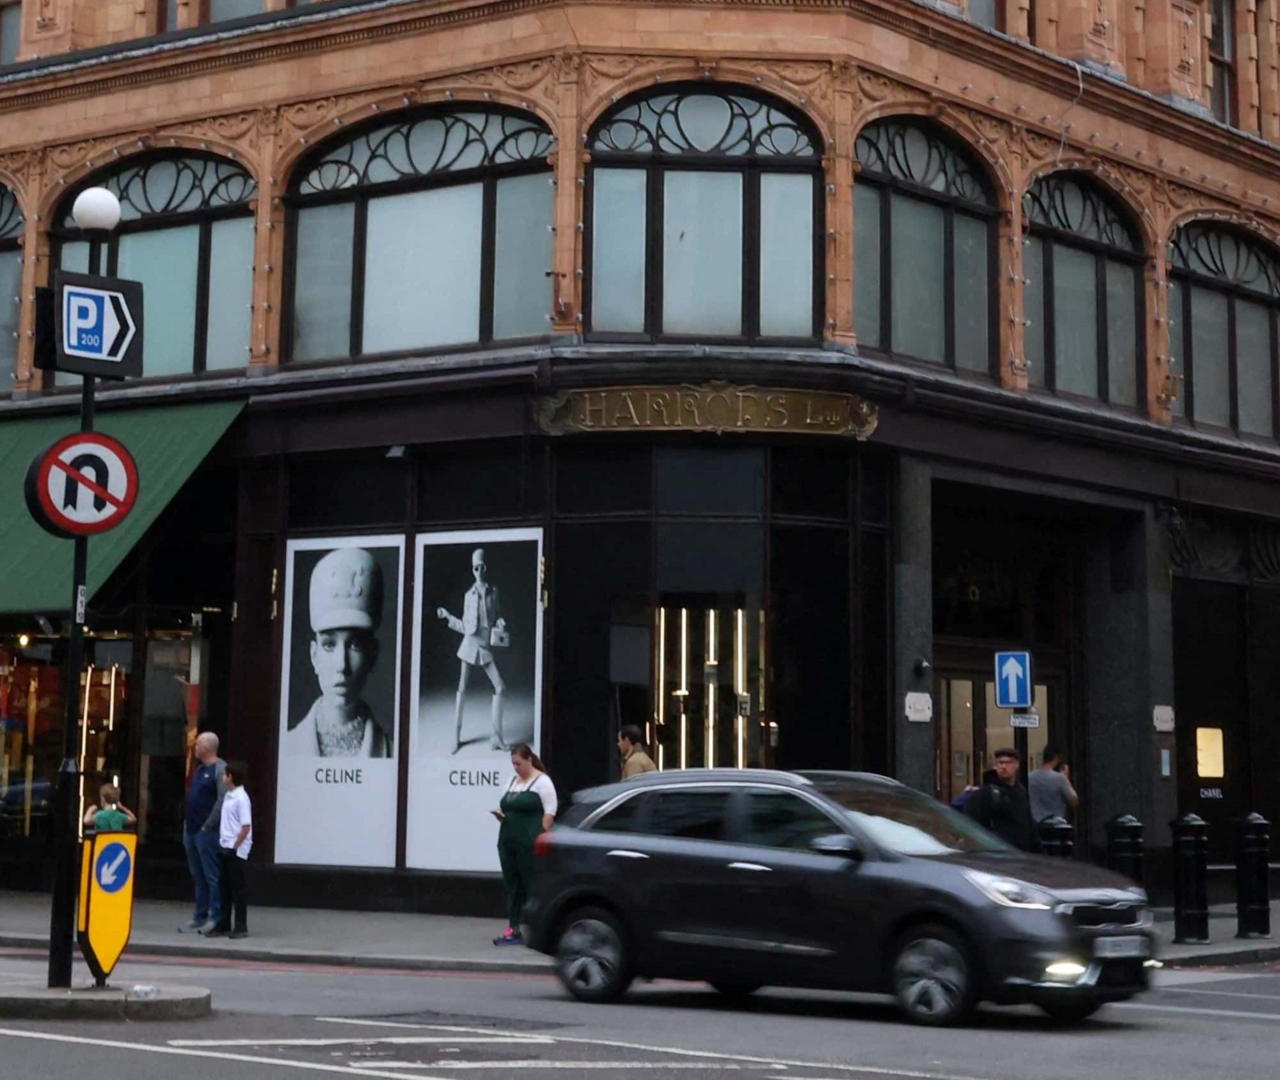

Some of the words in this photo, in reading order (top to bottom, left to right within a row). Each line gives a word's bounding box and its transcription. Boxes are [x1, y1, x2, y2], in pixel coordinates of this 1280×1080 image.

[68, 295, 98, 347] P
[81, 333, 100, 348] 200
[581, 391, 788, 427] HARRODS
[314, 768, 363, 785] CELINE
[448, 769, 501, 787] CELINE
[1199, 787, 1223, 799] CHANEL
